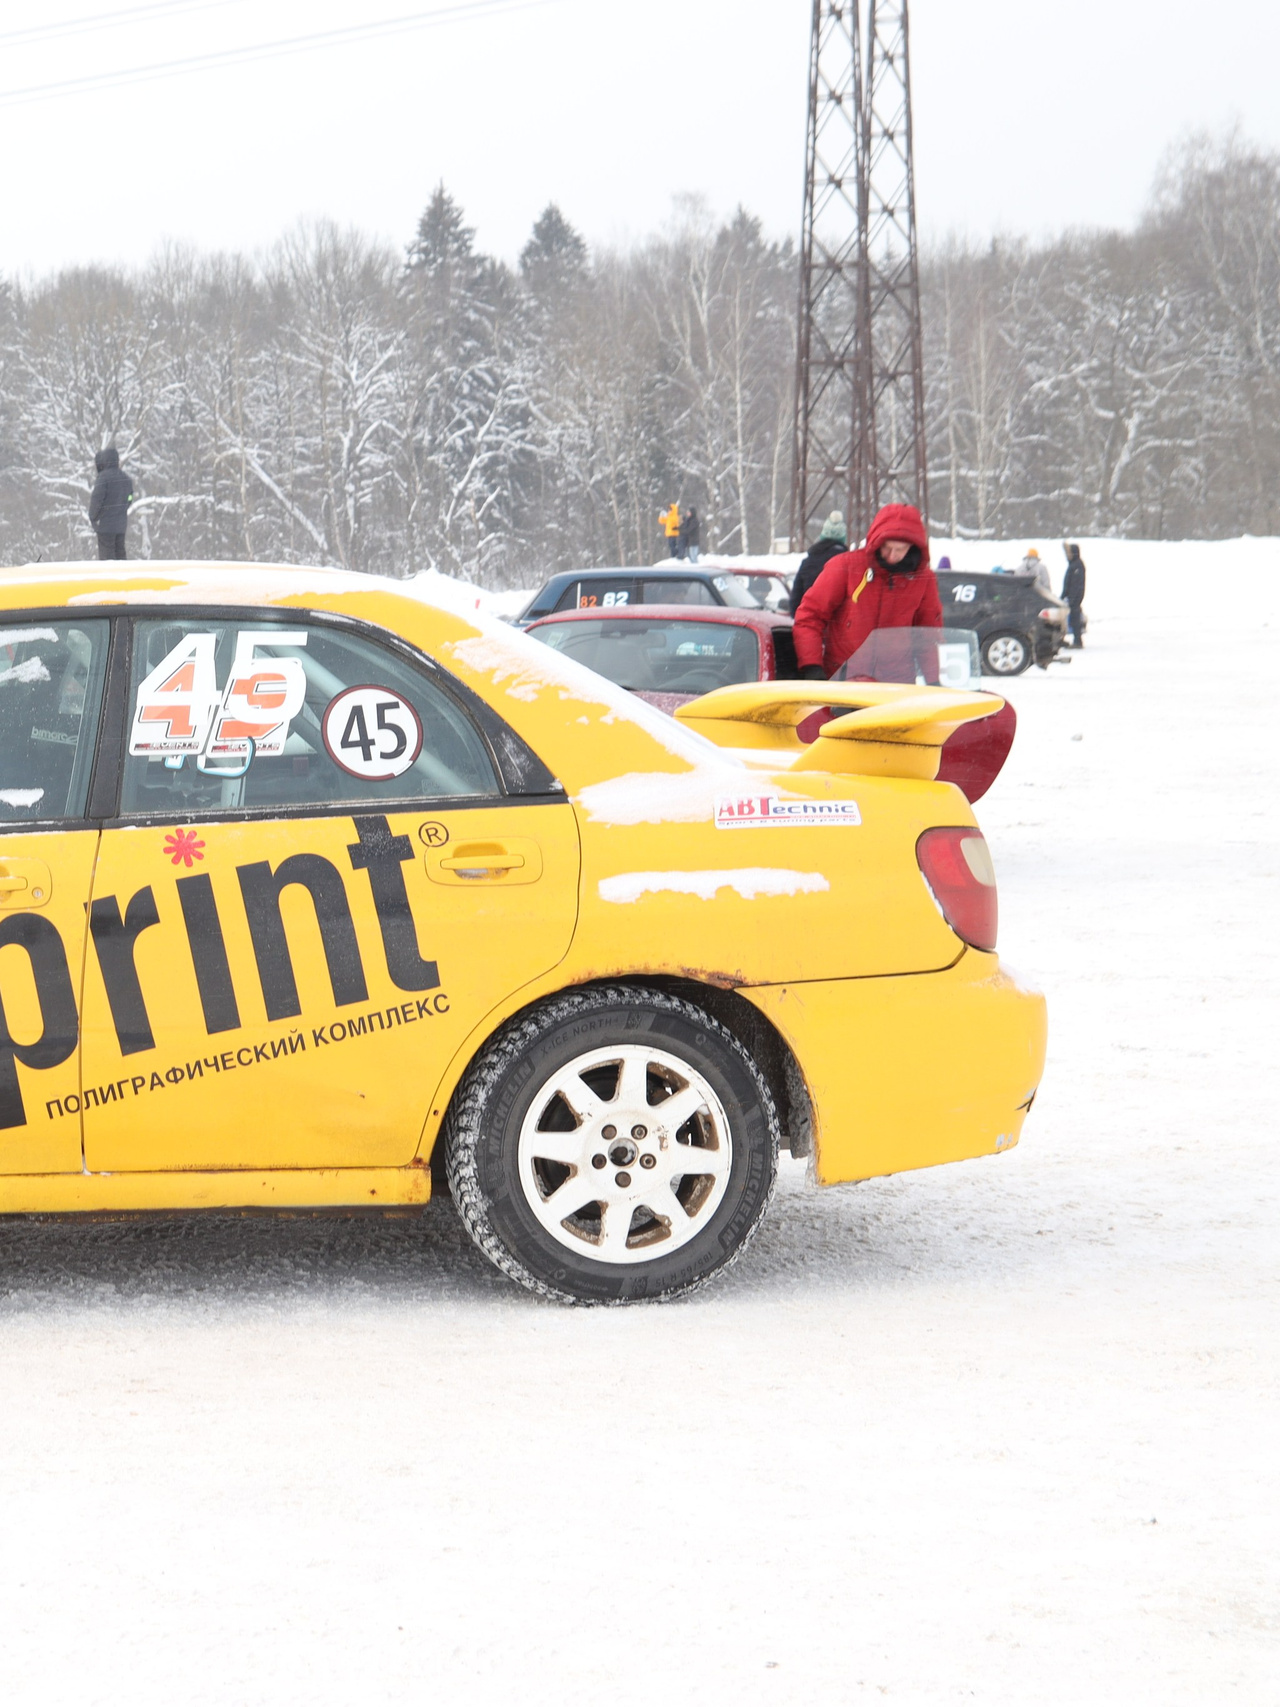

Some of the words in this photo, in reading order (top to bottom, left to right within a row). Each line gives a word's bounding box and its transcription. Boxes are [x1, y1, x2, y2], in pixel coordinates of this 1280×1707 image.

[580, 595, 597, 608] 82
[602, 591, 629, 607] 82
[951, 584, 977, 603] 16
[339, 700, 408, 763] 45
[571, 1017, 612, 1037] NORTH
[45, 1028, 307, 1120] ПОЛИГРАФИЧЕСКИЙ
[313, 993, 451, 1048] КОМПЛЕКС
[487, 1059, 533, 1157] MICHELIN
[721, 1150, 765, 1247] MICHELIN
